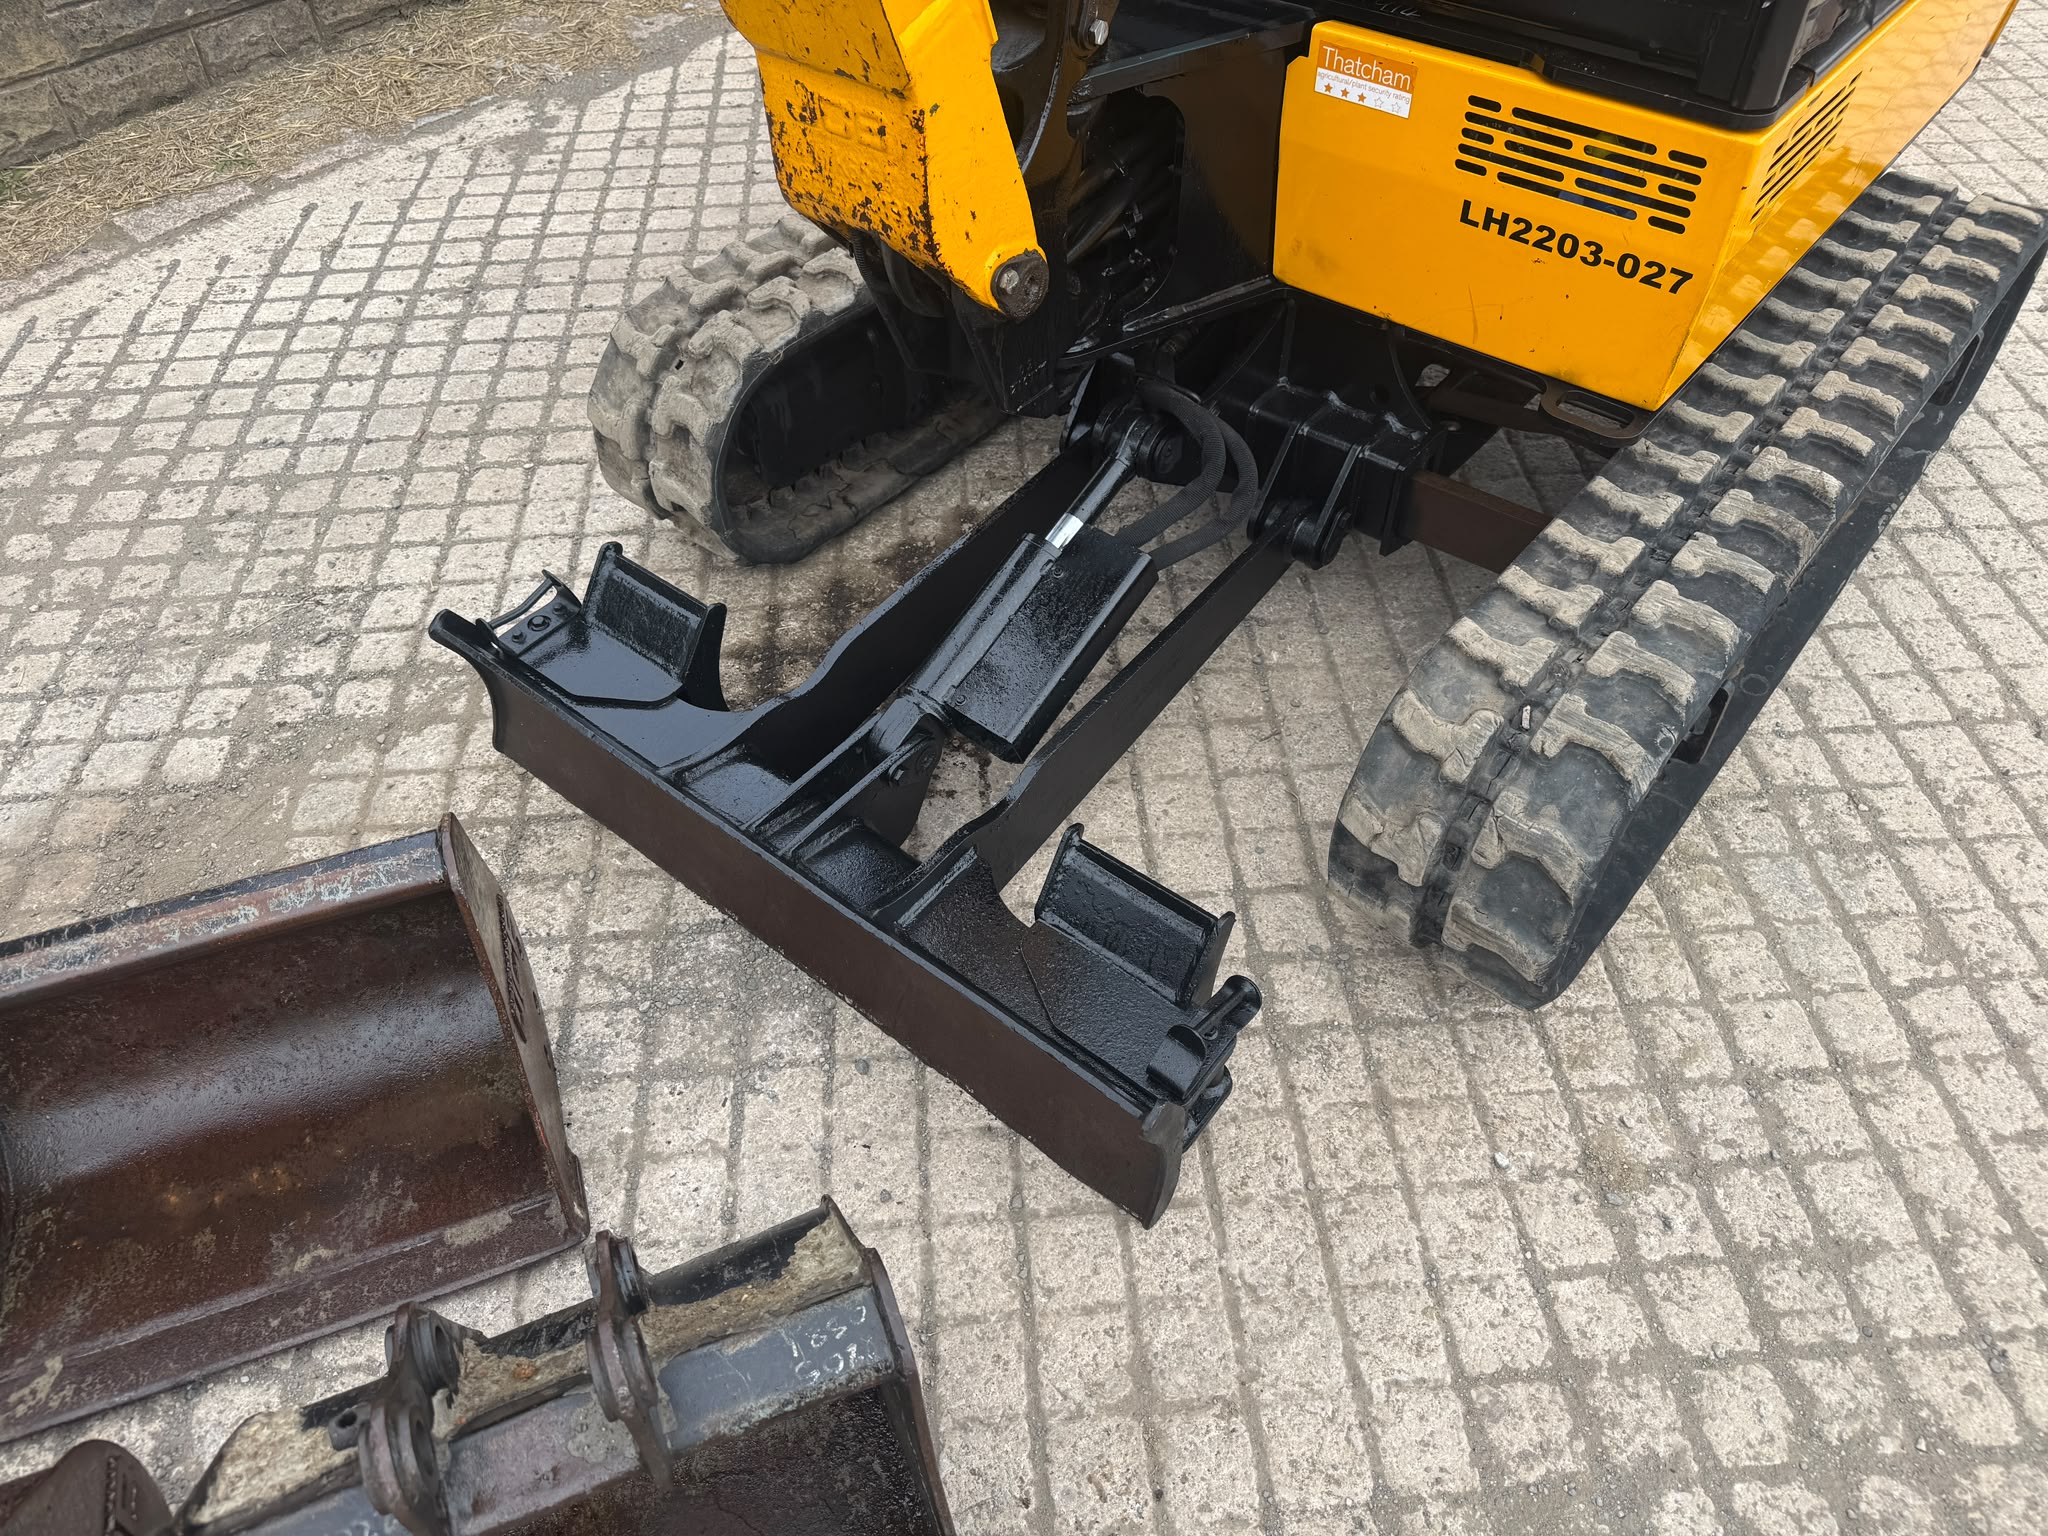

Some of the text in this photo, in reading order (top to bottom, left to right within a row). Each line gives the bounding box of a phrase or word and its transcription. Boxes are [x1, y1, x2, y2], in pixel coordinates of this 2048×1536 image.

[1317, 70, 1411, 105] agricultural/plant security rating
[1322, 45, 1411, 91] Thatcham
[1459, 199, 1694, 295] LH2203-027
